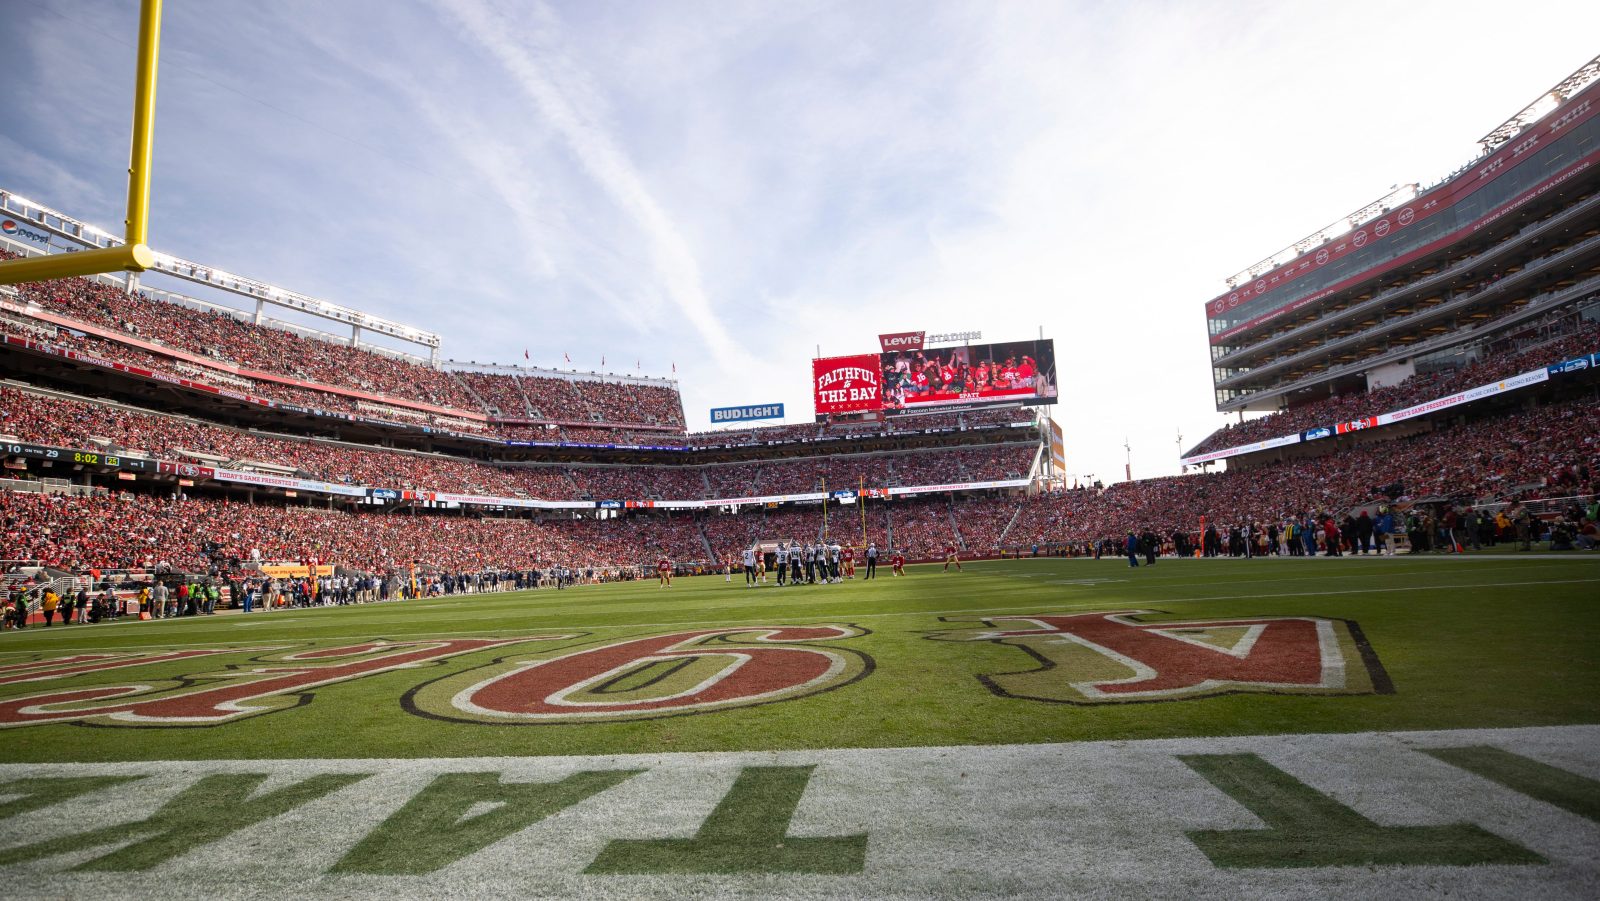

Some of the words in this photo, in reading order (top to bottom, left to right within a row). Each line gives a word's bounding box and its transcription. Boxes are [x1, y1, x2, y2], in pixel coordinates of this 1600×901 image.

[1501, 193, 1536, 214] DIVISION
[1537, 162, 1590, 194] CHAMPIONS
[18, 228, 49, 244] pepsi
[884, 335, 921, 347] Levi's
[929, 331, 982, 343] STADIUM
[74, 353, 114, 368] TURNOVERS
[817, 367, 877, 390] FAITHFUL
[843, 379, 852, 389] to
[819, 390, 847, 403] THE
[850, 387, 877, 401] BAY
[1392, 410, 1411, 420] TODAY'S
[1411, 405, 1426, 415] GAME
[1426, 397, 1457, 410] PRESENTED
[1457, 394, 1465, 402] BY
[7, 444, 21, 453] 10
[46, 449, 59, 458] 29
[74, 452, 98, 464] 8:02
[108, 457, 117, 465] 25
[219, 471, 243, 480] TODAY'S
[244, 474, 260, 482] GAME
[261, 476, 291, 486] PRESENTED
